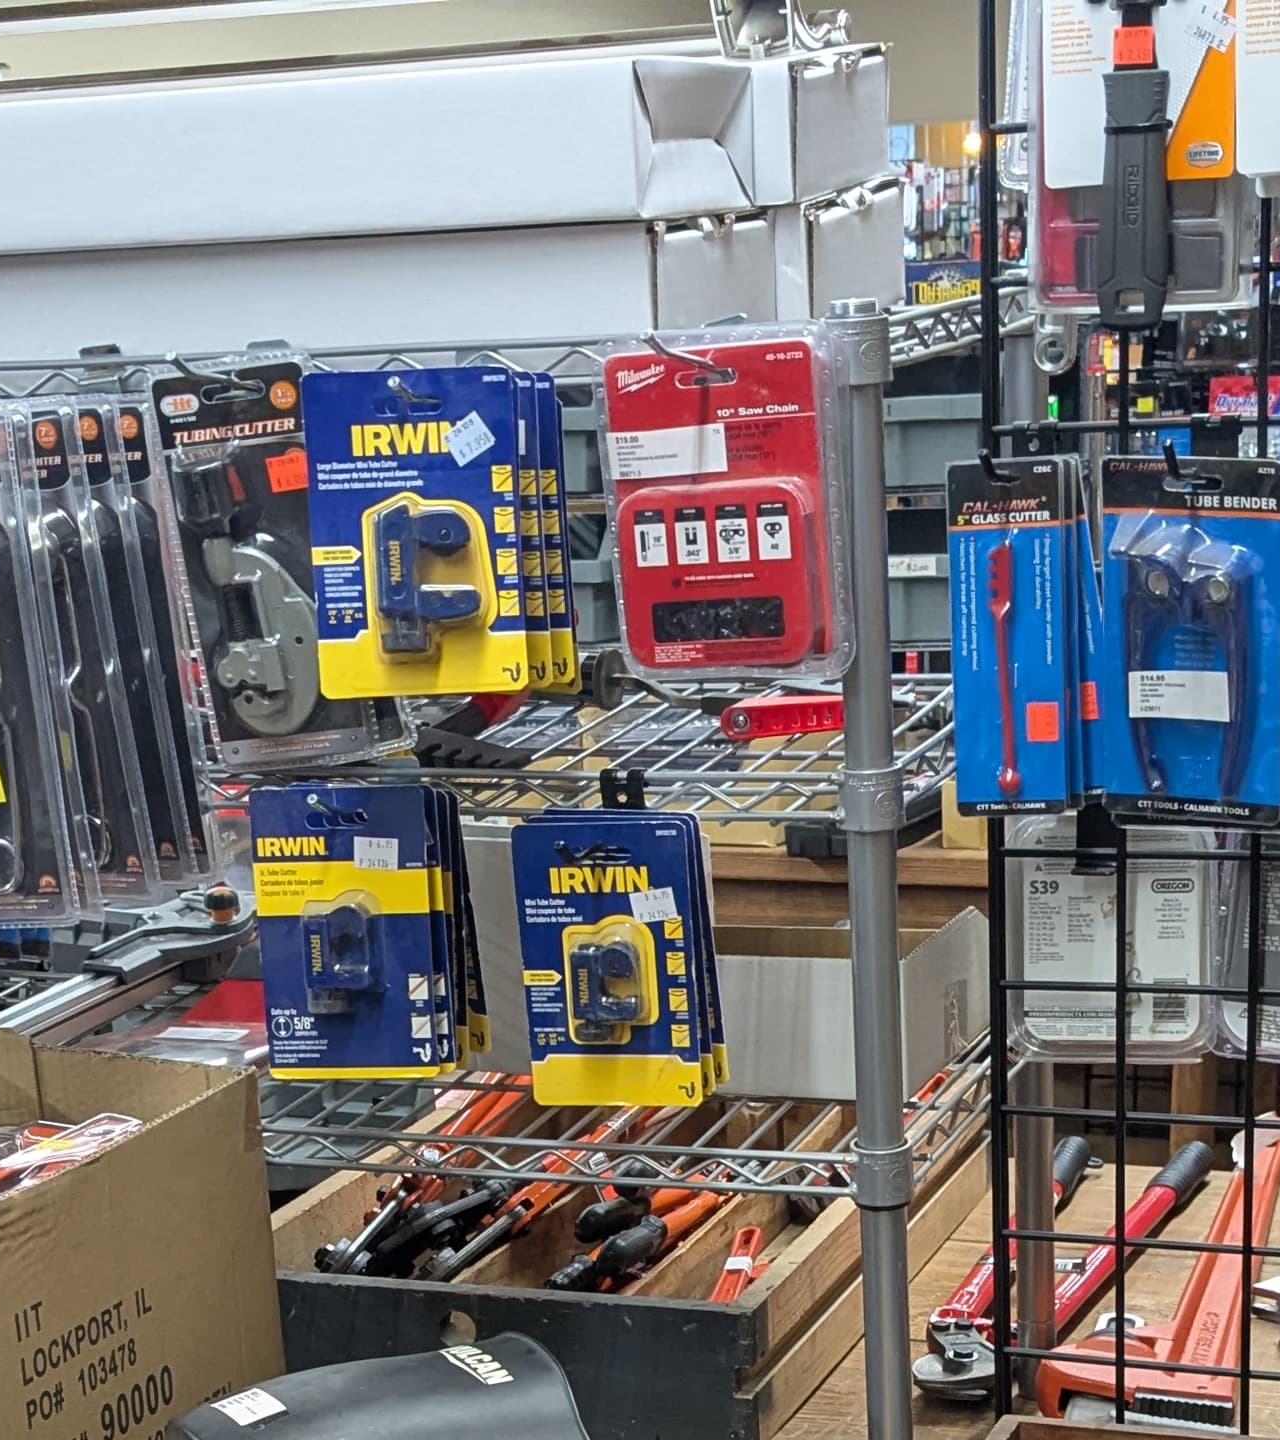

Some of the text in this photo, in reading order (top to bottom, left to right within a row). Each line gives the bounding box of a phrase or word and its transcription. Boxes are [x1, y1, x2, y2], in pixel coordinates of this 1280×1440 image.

[1126, 164, 1140, 229] RIDGID
[616, 364, 666, 388] Milwaukee
[738, 406, 763, 416] Saw
[766, 403, 800, 414] Chain
[173, 417, 297, 445] TUBING CUTTER
[961, 498, 1040, 513] CAL-HAWK
[1184, 495, 1277, 510] TUBE BENDER
[956, 510, 1051, 525] 5" GLASS CUTTER
[388, 540, 402, 583] IRWIN
[1137, 799, 1153, 810] CTT
[1154, 800, 1178, 811] TOOLS
[1223, 805, 1250, 816] TOOLS
[256, 836, 325, 857] IRWIN
[267, 868, 279, 876] Tube
[280, 868, 298, 876] Cutter
[549, 865, 649, 895] IRWIN
[260, 878, 287, 888] Cortadora
[1029, 879, 1061, 895] S39
[1154, 881, 1191, 891] OREGON
[525, 898, 566, 907] Mini Tube Cutter
[310, 934, 323, 976] IRWIN
[577, 967, 589, 1005] IRWIN
[293, 1016, 316, 1030] 5/8"
[14, 1300, 44, 1344] IIT
[21, 1287, 153, 1388] LOCKPORT, IL
[25, 1337, 138, 1431] PO# 103478
